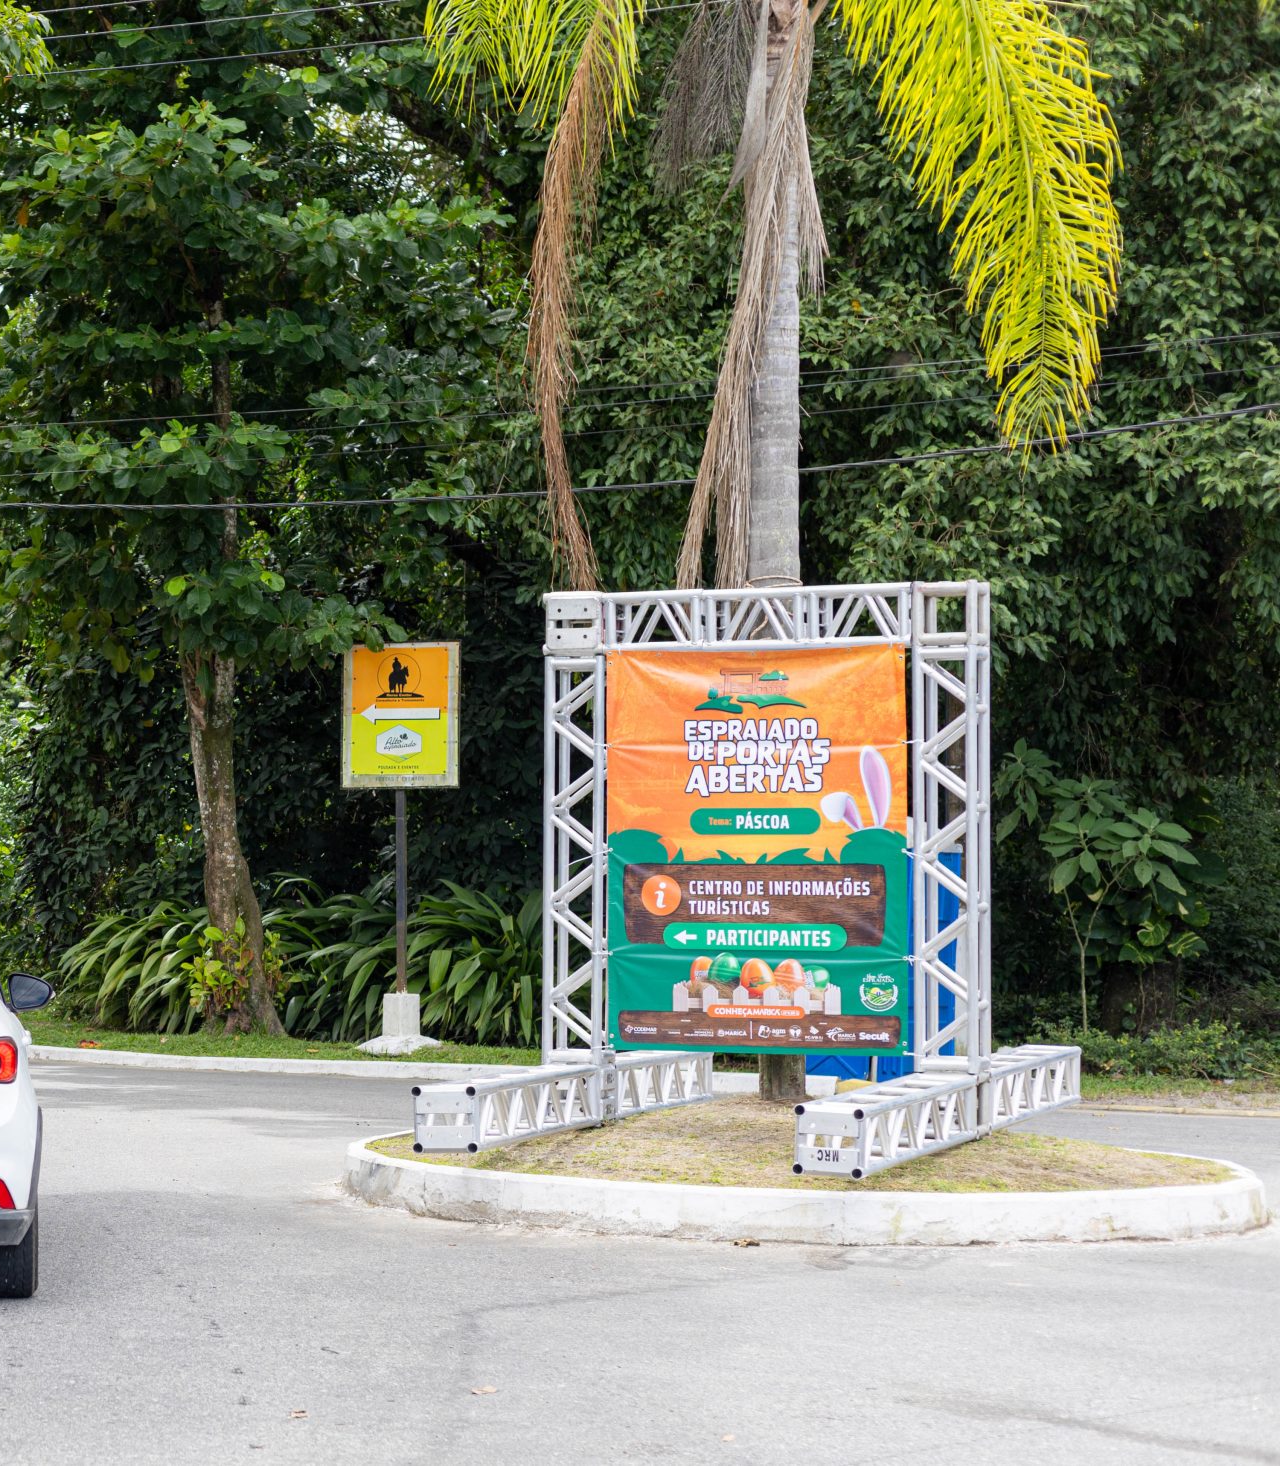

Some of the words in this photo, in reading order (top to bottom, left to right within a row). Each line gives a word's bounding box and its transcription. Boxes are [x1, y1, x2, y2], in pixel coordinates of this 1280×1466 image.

[684, 718, 818, 743] ESPRAIADO
[385, 736, 403, 746] Alto
[688, 740, 716, 763] DE
[716, 738, 831, 769] PORTAS
[685, 764, 823, 797] ABERTAS
[708, 817, 732, 826] Tema:
[735, 811, 790, 830] PÁSCOA
[689, 880, 742, 896] CENTRO
[746, 880, 764, 896] DE
[769, 877, 870, 899] INFORMAÇÕES
[689, 897, 770, 916] TURÍSTICAS
[706, 929, 831, 947] PARTICIPANTES
[817, 1149, 839, 1162] MRC
